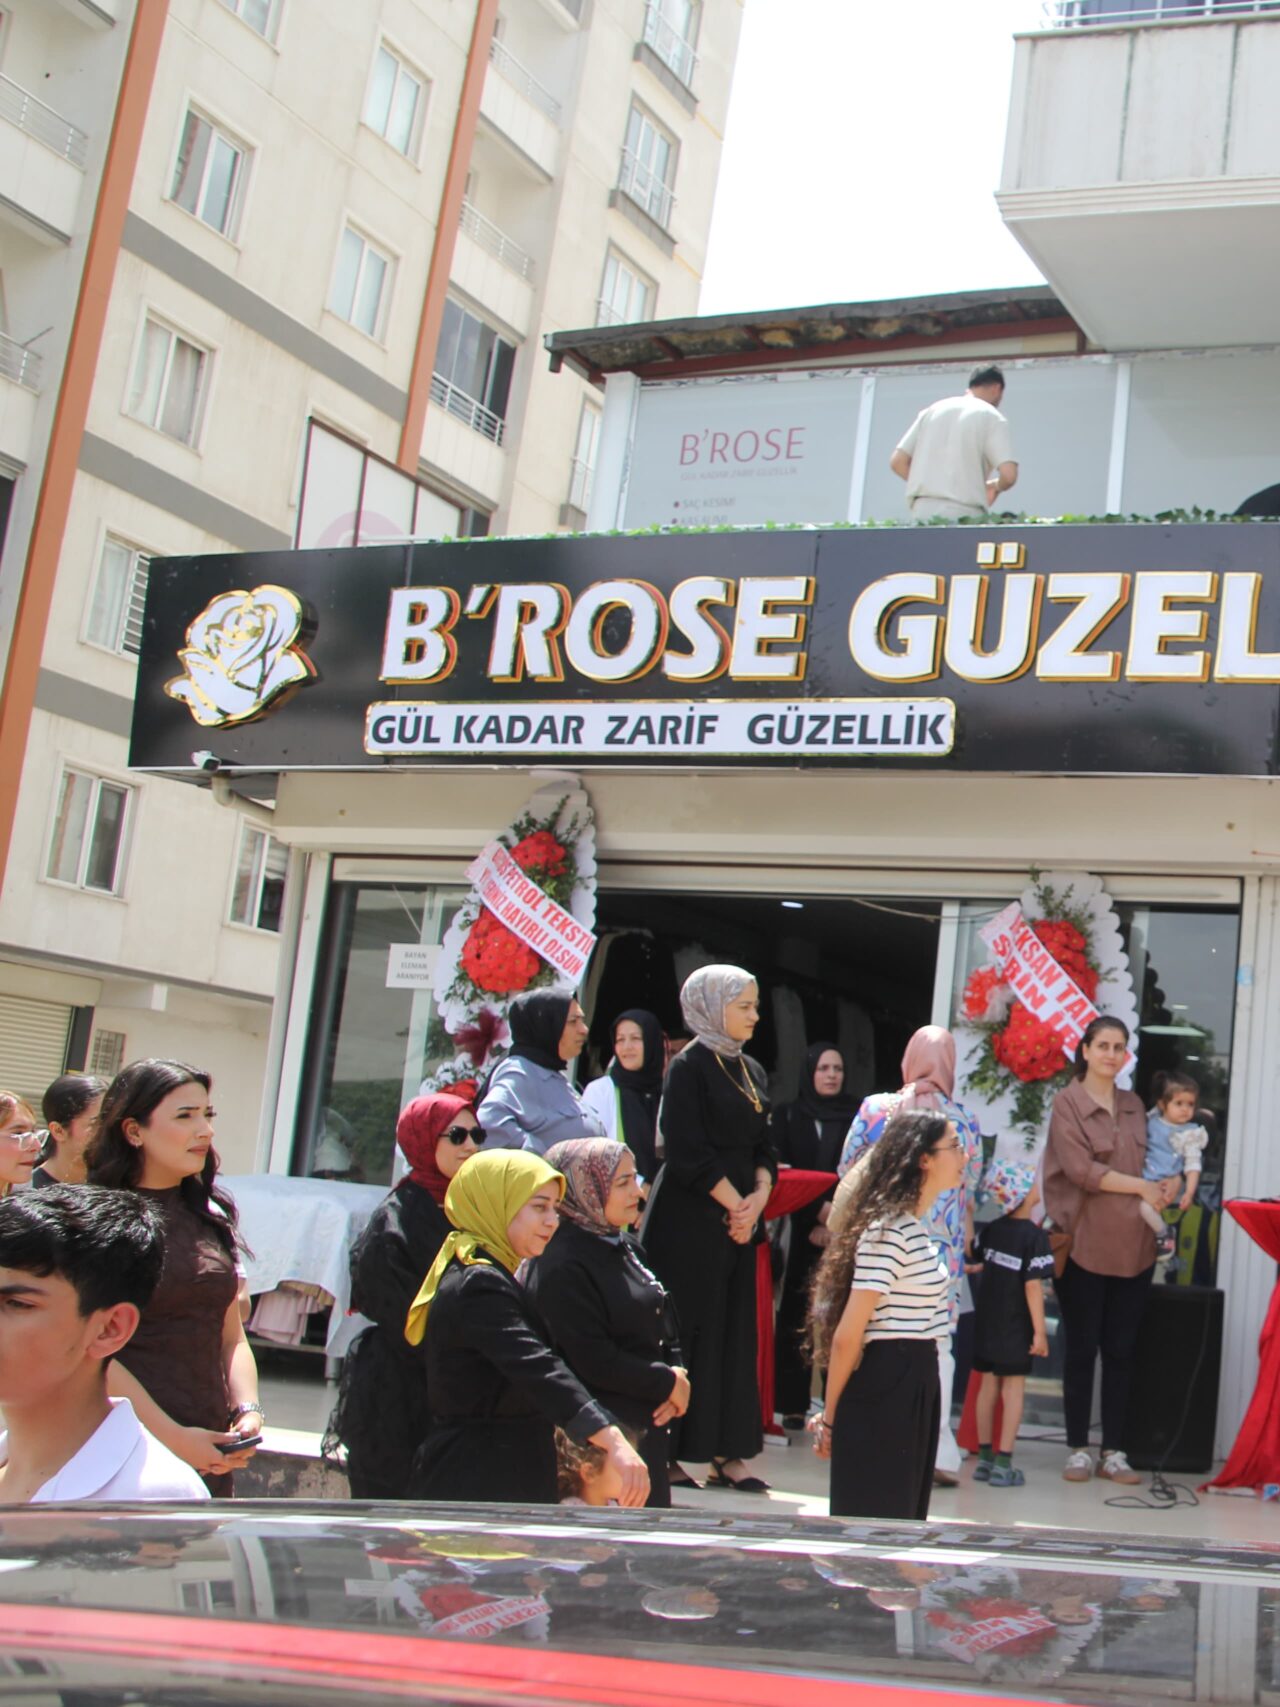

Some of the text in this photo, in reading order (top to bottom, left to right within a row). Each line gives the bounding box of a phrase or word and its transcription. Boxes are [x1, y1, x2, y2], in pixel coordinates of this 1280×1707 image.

[679, 427, 806, 466] B'ROSE
[378, 575, 814, 684] B'ROSE
[371, 705, 947, 745] GÜL KADAR ZARİF GÜZELLİK
[501, 901, 549, 946] HAYIRLI
[543, 938, 584, 976] OLSUN
